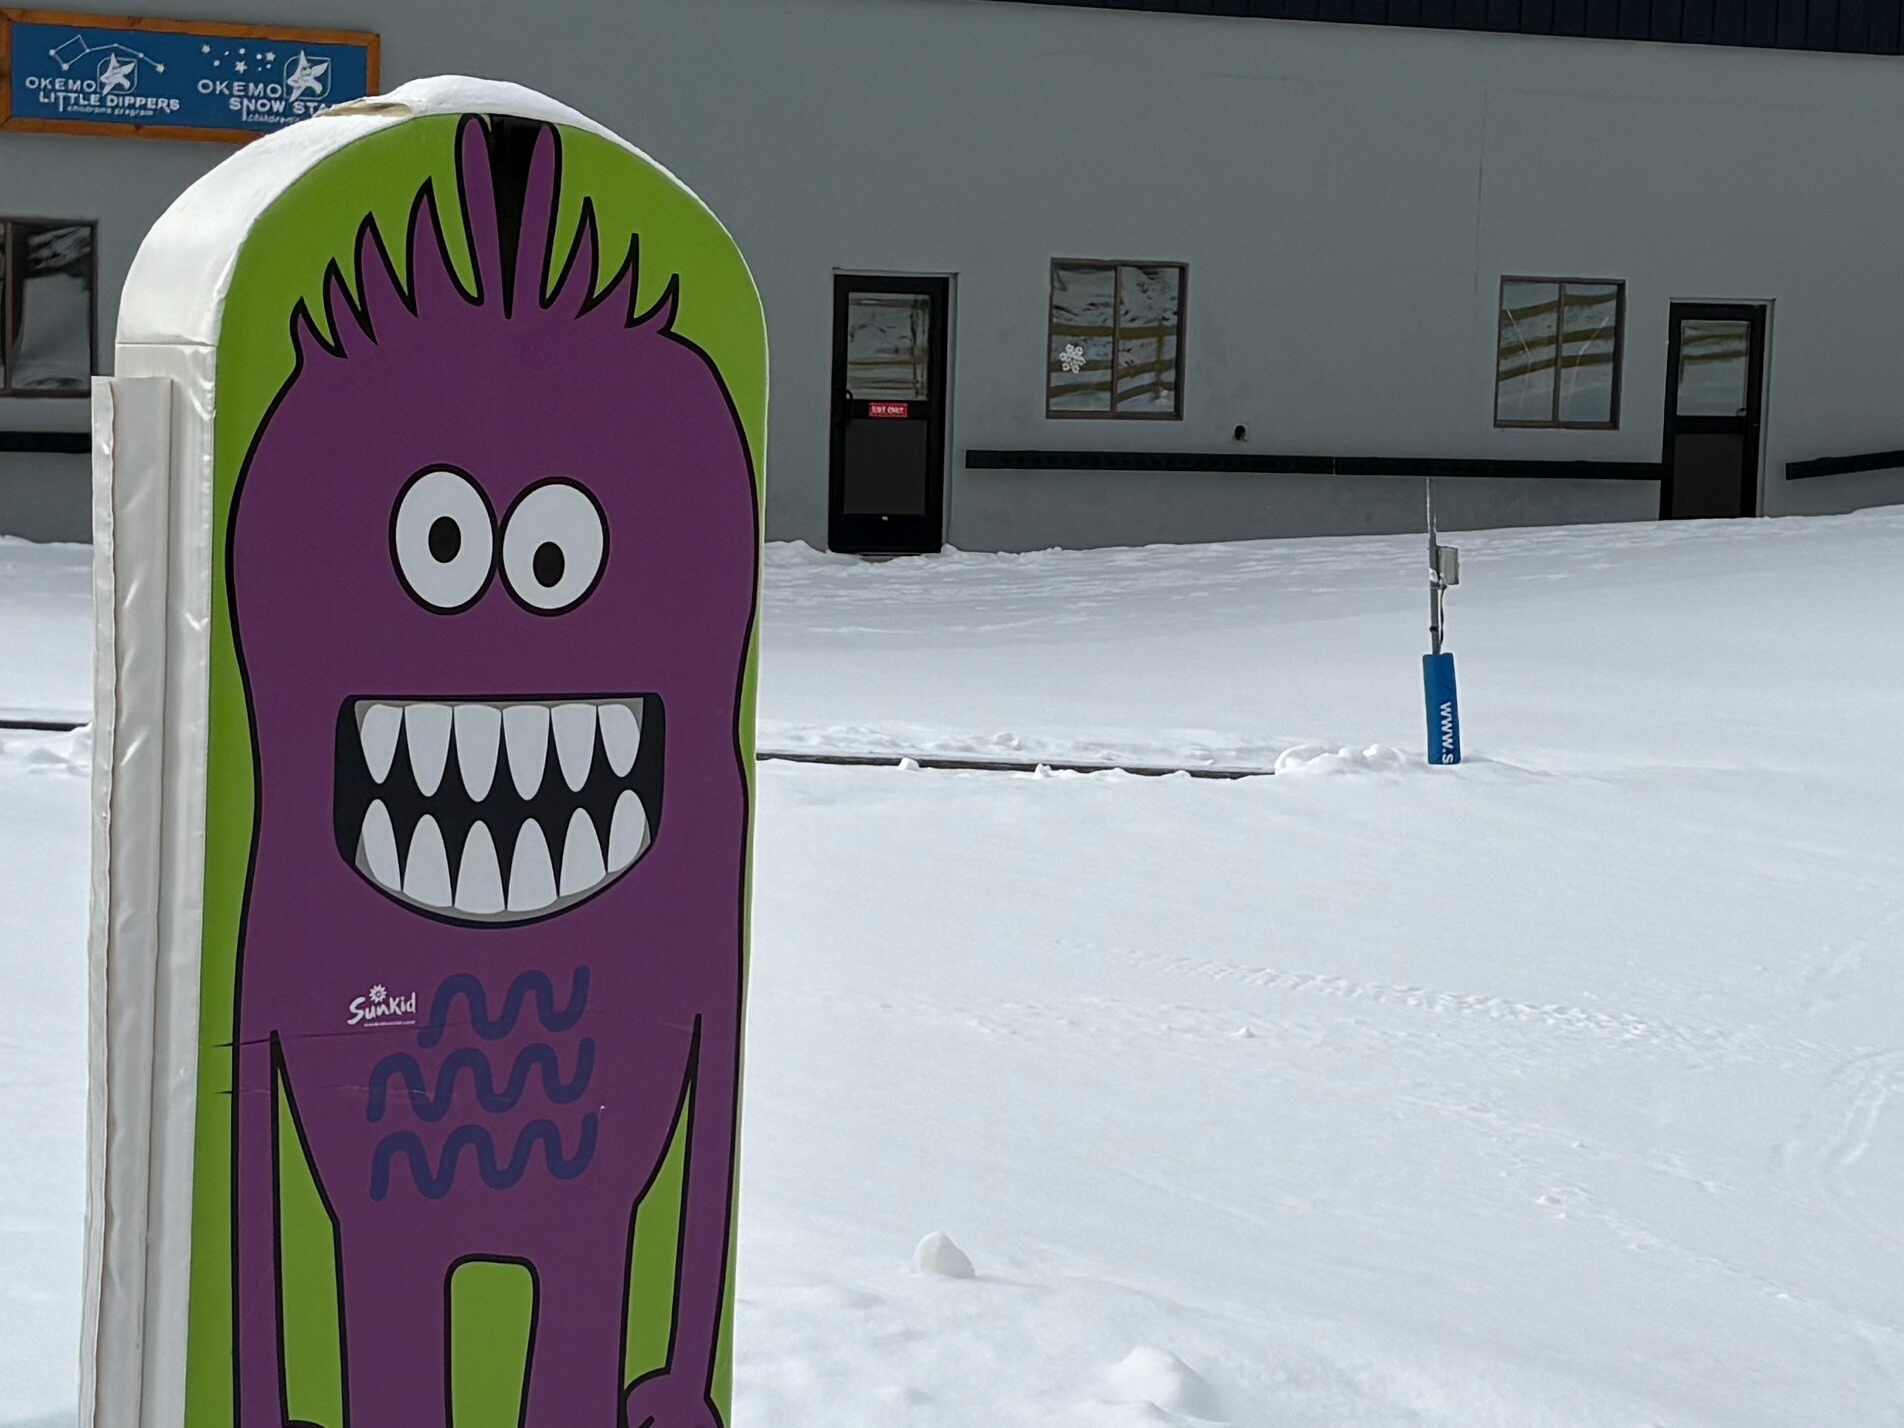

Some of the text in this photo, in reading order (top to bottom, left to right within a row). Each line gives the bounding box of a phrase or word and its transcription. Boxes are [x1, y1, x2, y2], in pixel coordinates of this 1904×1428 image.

[25, 76, 96, 93] OKEMO
[197, 79, 283, 98] OKEMO
[39, 91, 180, 113] LITTLE DIPPERS
[228, 97, 331, 121] SNOW STA
